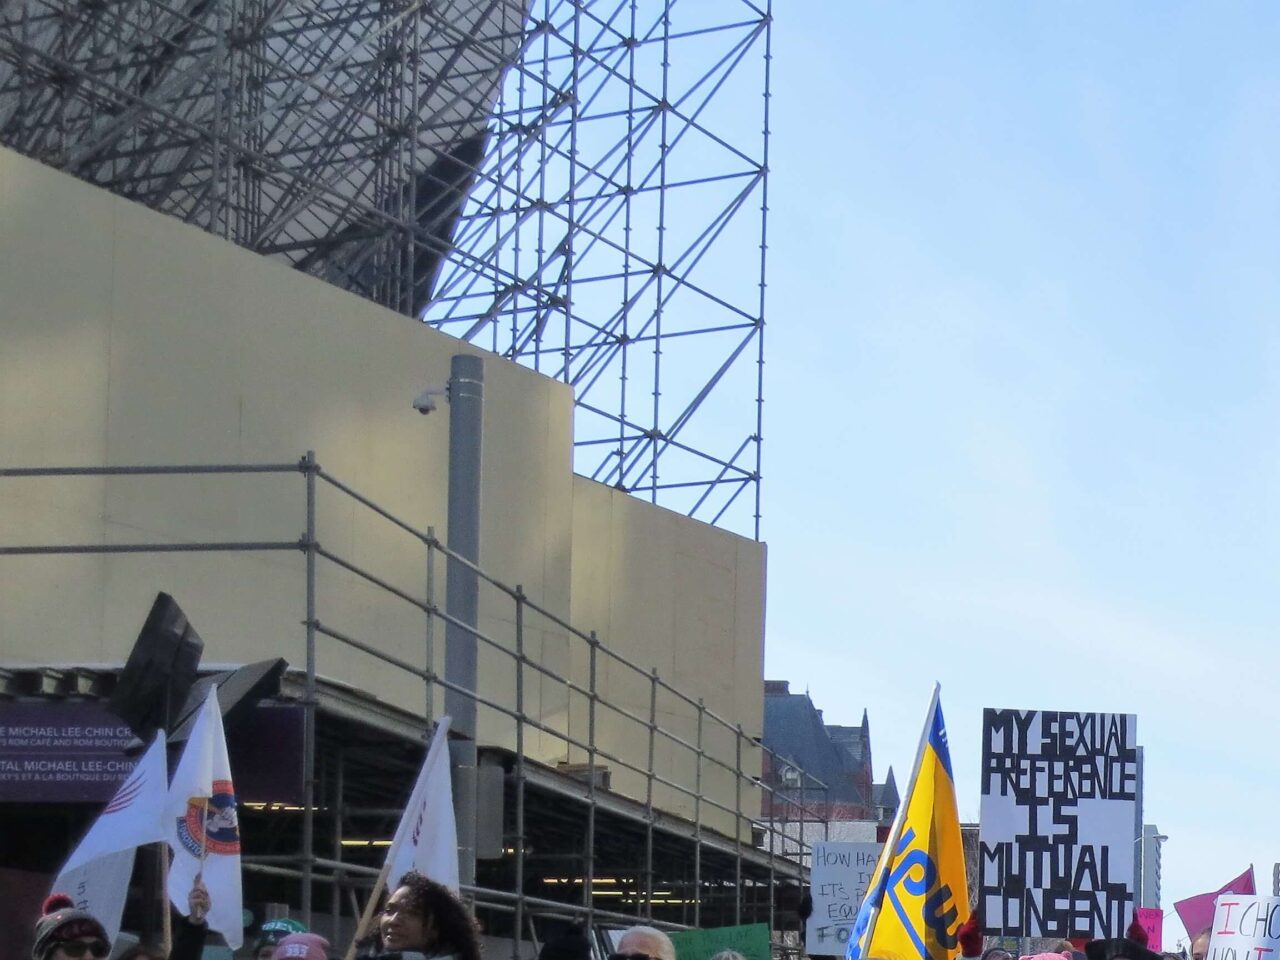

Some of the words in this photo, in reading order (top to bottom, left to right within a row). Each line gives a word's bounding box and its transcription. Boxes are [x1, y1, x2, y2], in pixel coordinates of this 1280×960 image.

[8, 727, 59, 737] MICHAEL
[62, 727, 114, 737] LEE-CHIN
[983, 708, 1037, 754] MY
[1041, 711, 1137, 759] SEXUAL
[0, 761, 20, 771] TAL
[24, 761, 79, 771] MICHAEL
[981, 753, 1137, 801] PREFERENCE
[1015, 797, 1079, 845] IS
[816, 847, 851, 868] HOW
[856, 852, 880, 867] HA
[979, 841, 1128, 893] MUTUAL
[978, 886, 1134, 940] CONSENT
[1217, 902, 1240, 935] I
